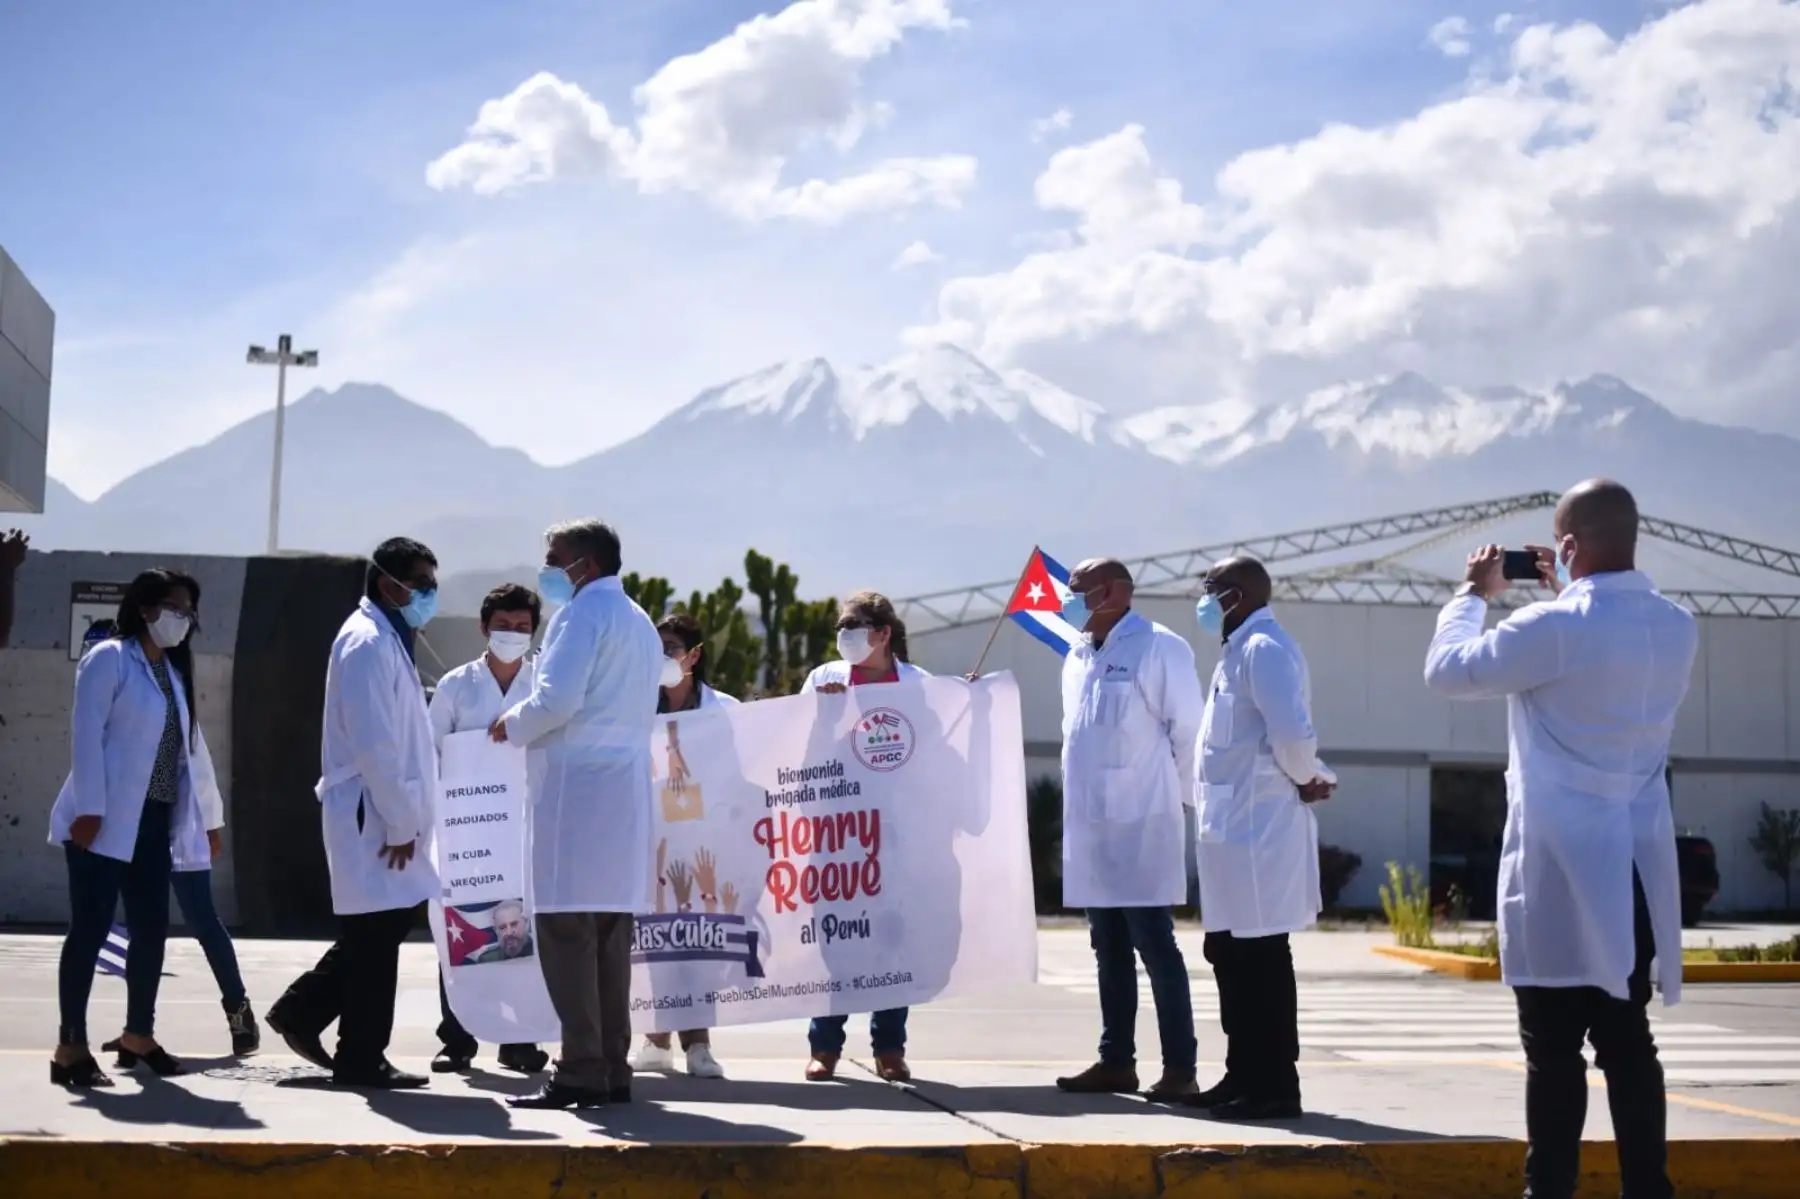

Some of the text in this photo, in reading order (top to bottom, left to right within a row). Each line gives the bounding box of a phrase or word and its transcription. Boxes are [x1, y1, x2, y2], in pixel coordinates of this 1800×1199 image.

[777, 759, 844, 785] bienvenida
[871, 752, 902, 765] APGC
[446, 784, 508, 799] PERUANOS
[765, 779, 861, 808] brigada médica
[753, 808, 881, 861] Henry
[462, 848, 492, 860] CUBA
[766, 856, 881, 914] Reeve
[670, 916, 727, 949] Cuba
[800, 909, 871, 945] al Perú
[852, 971, 913, 990] #CubaSalva
